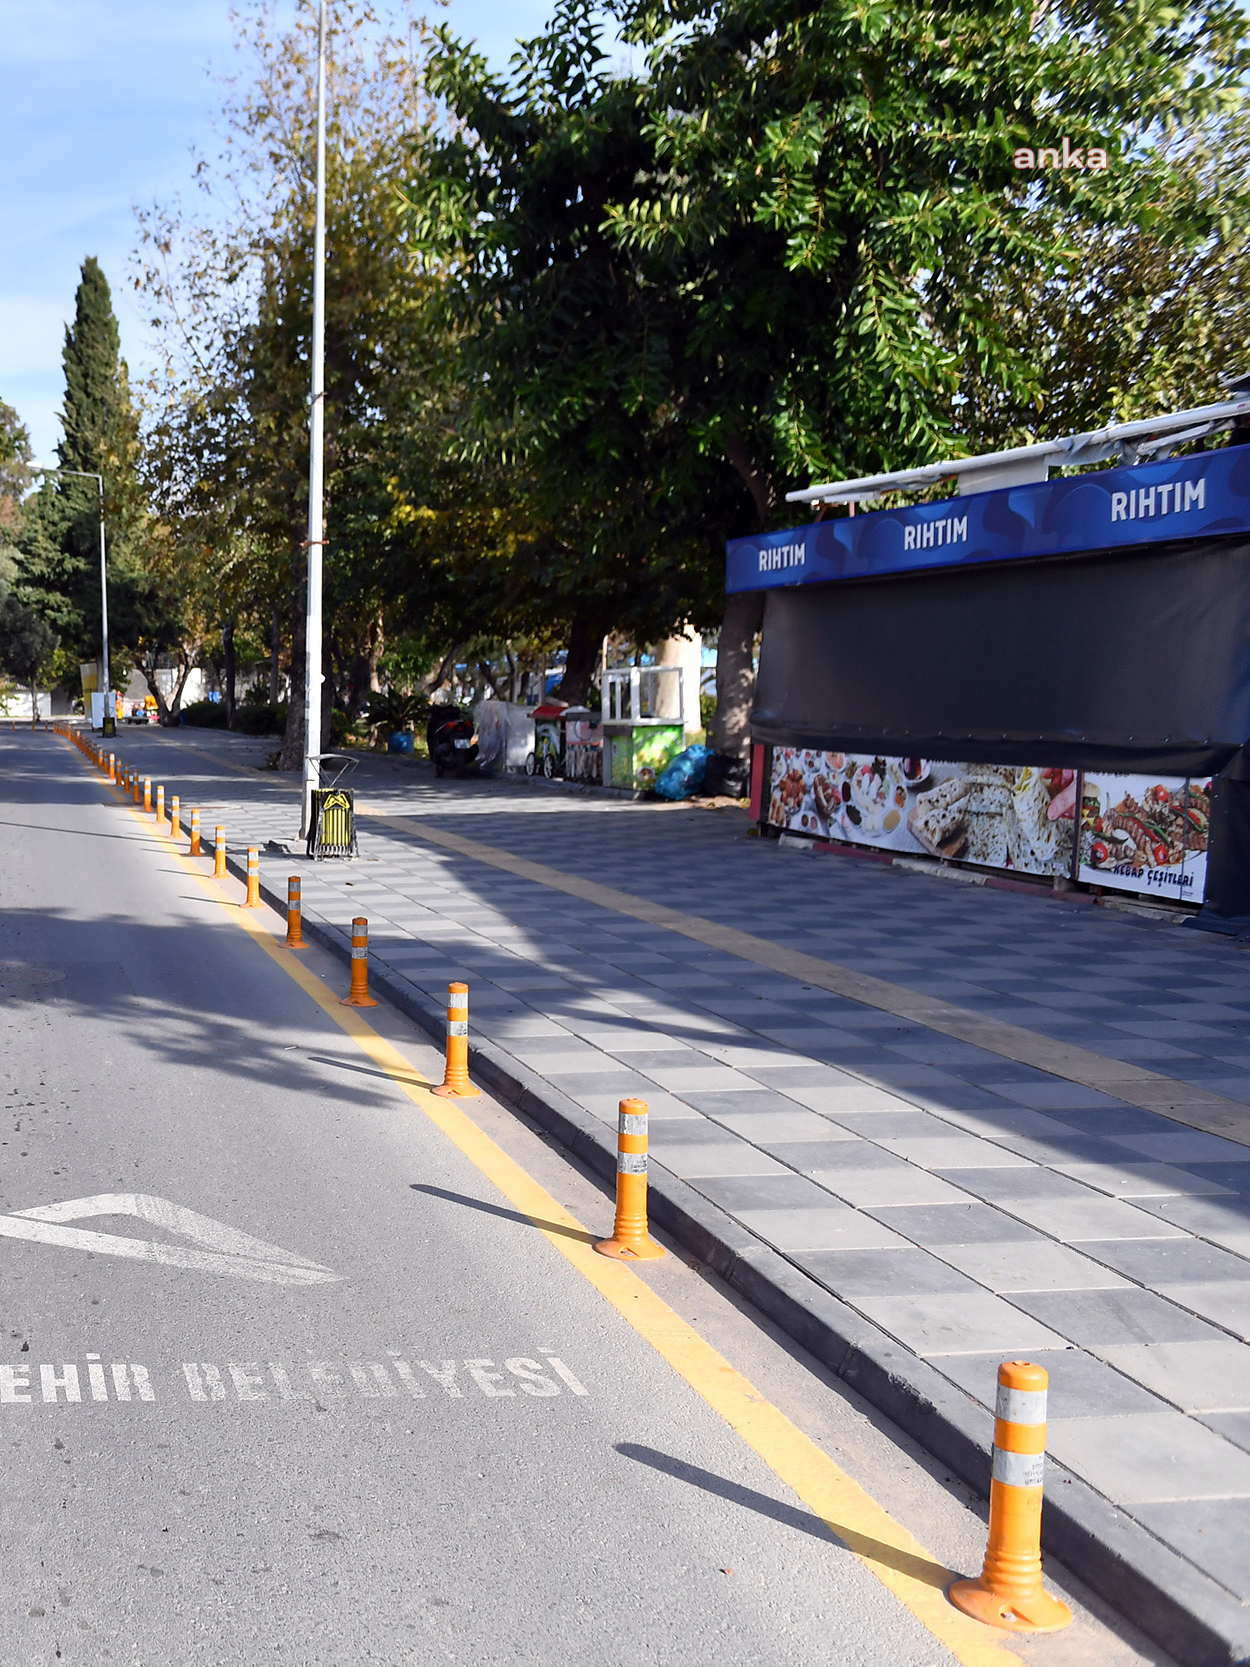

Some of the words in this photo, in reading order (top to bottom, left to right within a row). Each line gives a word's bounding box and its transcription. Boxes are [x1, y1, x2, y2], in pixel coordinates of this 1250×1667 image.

[1111, 477, 1206, 522] RIHTIM
[904, 515, 968, 551] RIHTIM
[758, 542, 806, 572] RIHTIM
[1114, 864, 1144, 879] KEBAP
[181, 1346, 591, 1403] BELEDİYESİ
